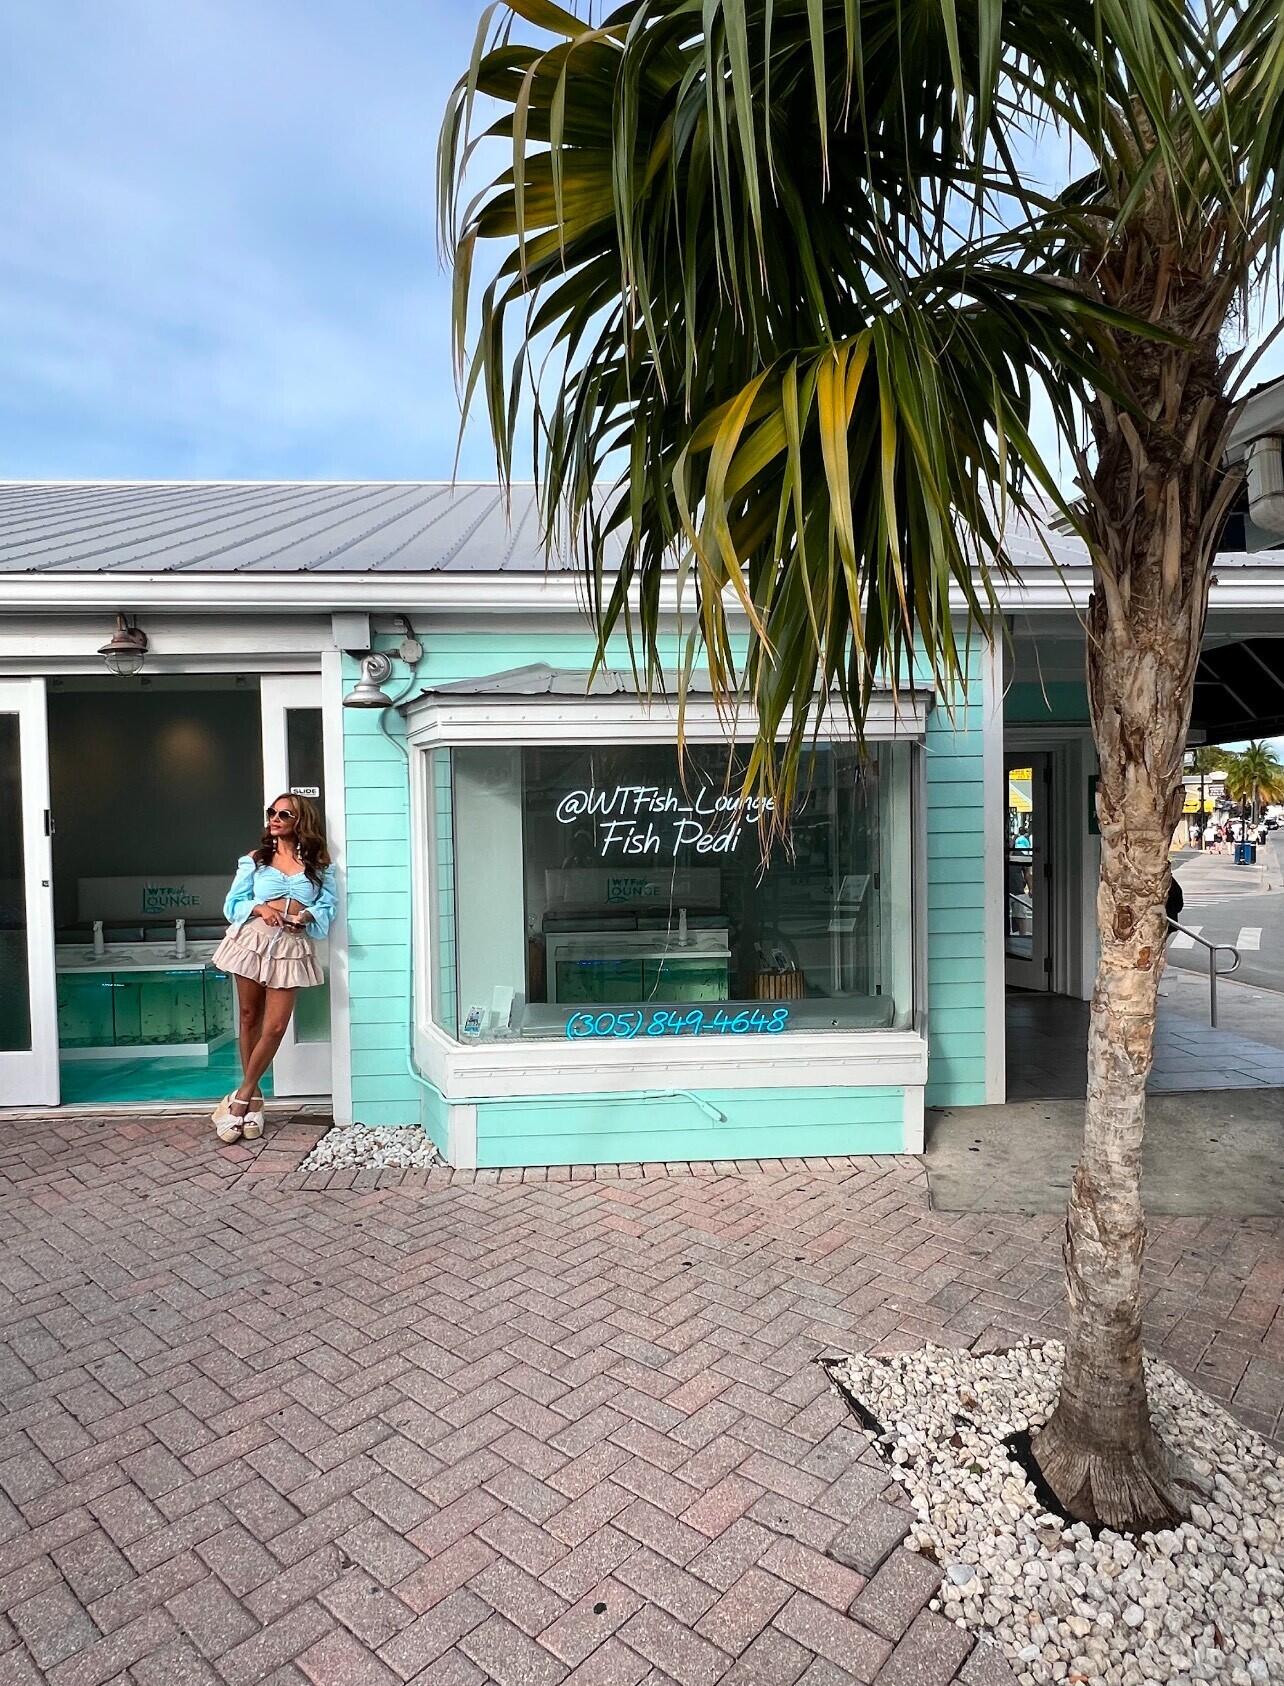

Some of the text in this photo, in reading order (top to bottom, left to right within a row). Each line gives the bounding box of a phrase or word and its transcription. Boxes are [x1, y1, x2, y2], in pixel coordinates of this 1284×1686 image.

[556, 785, 777, 823] @WTFish_Lounge
[600, 818, 742, 857] Fish Pedi
[566, 1008, 789, 1040] (305) 849-4648
